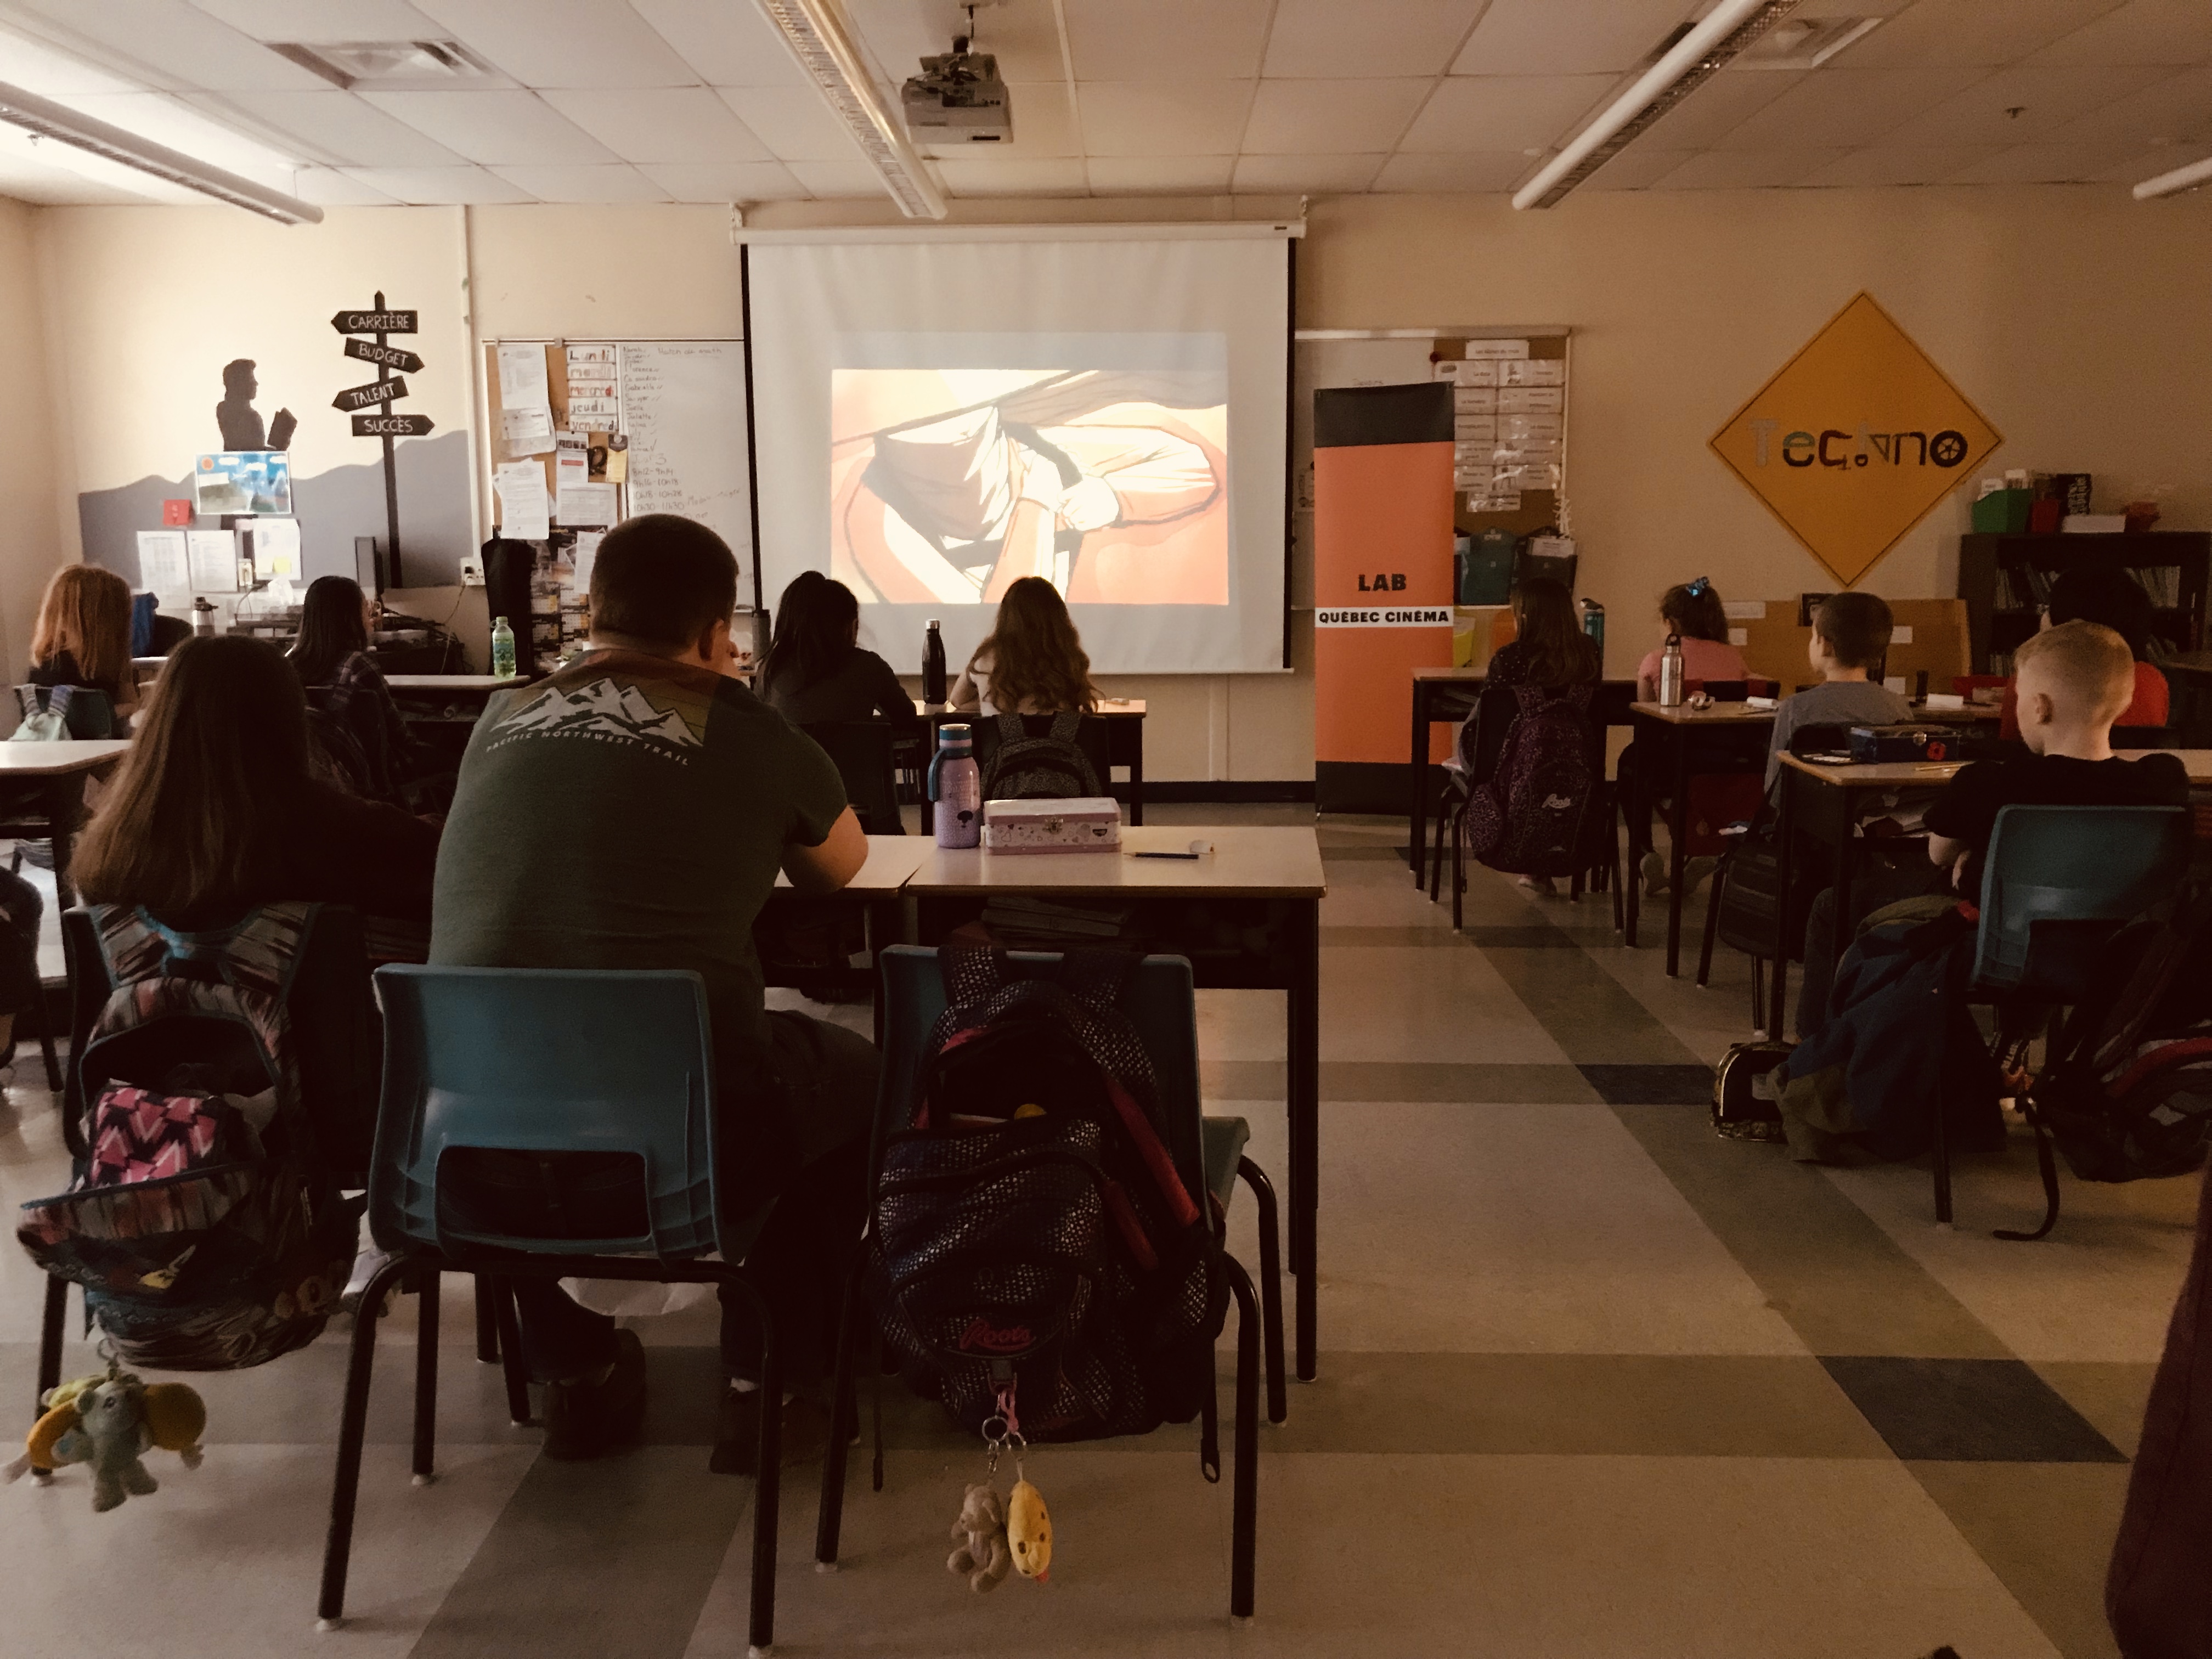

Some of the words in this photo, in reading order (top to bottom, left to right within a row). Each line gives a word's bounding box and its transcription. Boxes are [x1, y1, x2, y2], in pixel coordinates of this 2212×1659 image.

[348, 312, 410, 330] CARRIÈRE
[359, 343, 408, 366] BUDGET
[350, 383, 394, 406] TALENT
[572, 400, 603, 414] jeudi
[364, 416, 413, 433] SUCCÈS
[656, 453, 667, 465] 3
[1358, 573, 1406, 591] LAB
[1319, 611, 1380, 624] QUÉBEC
[1385, 610, 1449, 623] CINÉMA
[487, 732, 532, 753] PACIFIC
[541, 730, 634, 745] NORTHWEST
[643, 742, 689, 766] TRAIL
